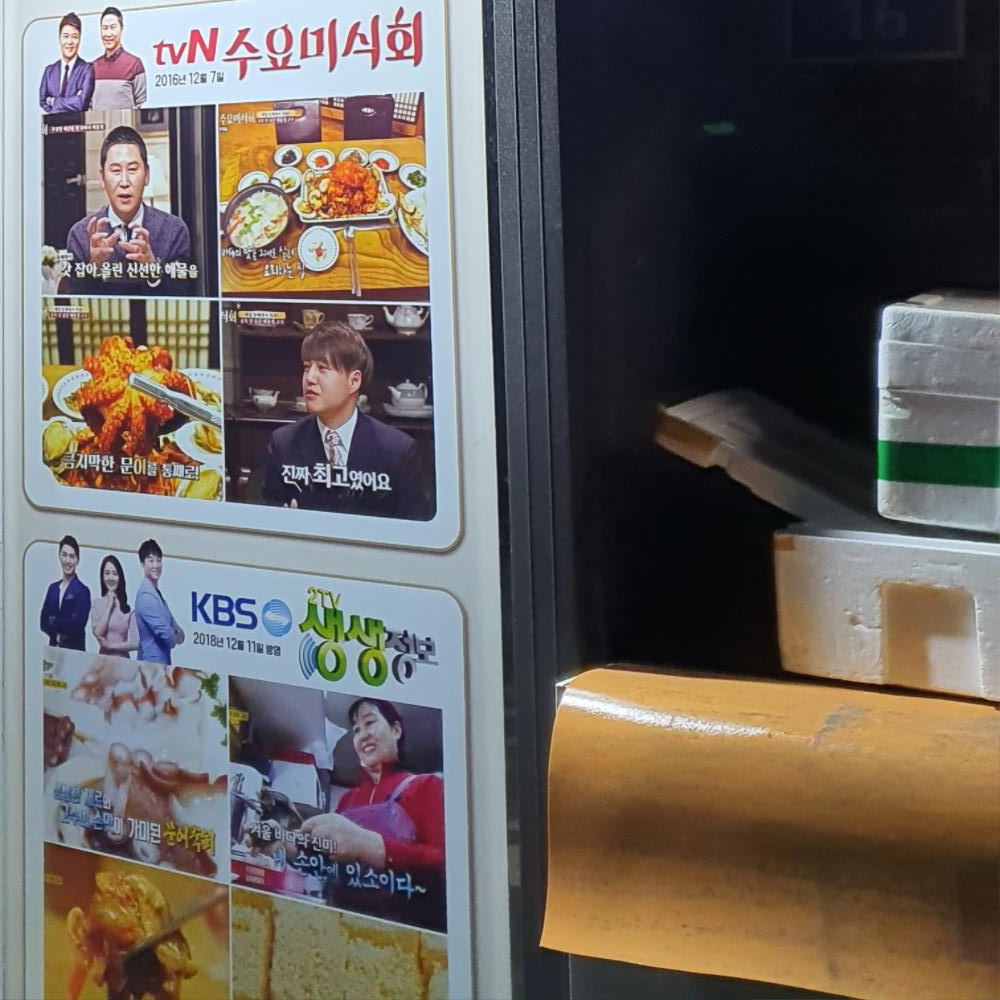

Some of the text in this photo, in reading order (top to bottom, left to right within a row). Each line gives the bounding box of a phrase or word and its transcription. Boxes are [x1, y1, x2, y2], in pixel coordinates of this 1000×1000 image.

[154, 6, 424, 81] tvN 수요미식회
[155, 70, 225, 88] 2016년 12월 7일
[74, 262, 97, 278] 잡아
[100, 262, 123, 279] 올린
[126, 262, 162, 279] 신선한
[164, 261, 199, 279] 해물을
[281, 462, 392, 492] 진짜 최고였어요
[191, 591, 258, 631] KBS
[193, 631, 225, 648] 2018년
[226, 636, 244, 651] 12월
[247, 639, 265, 654] 11일
[126, 817, 162, 844] 가미된
